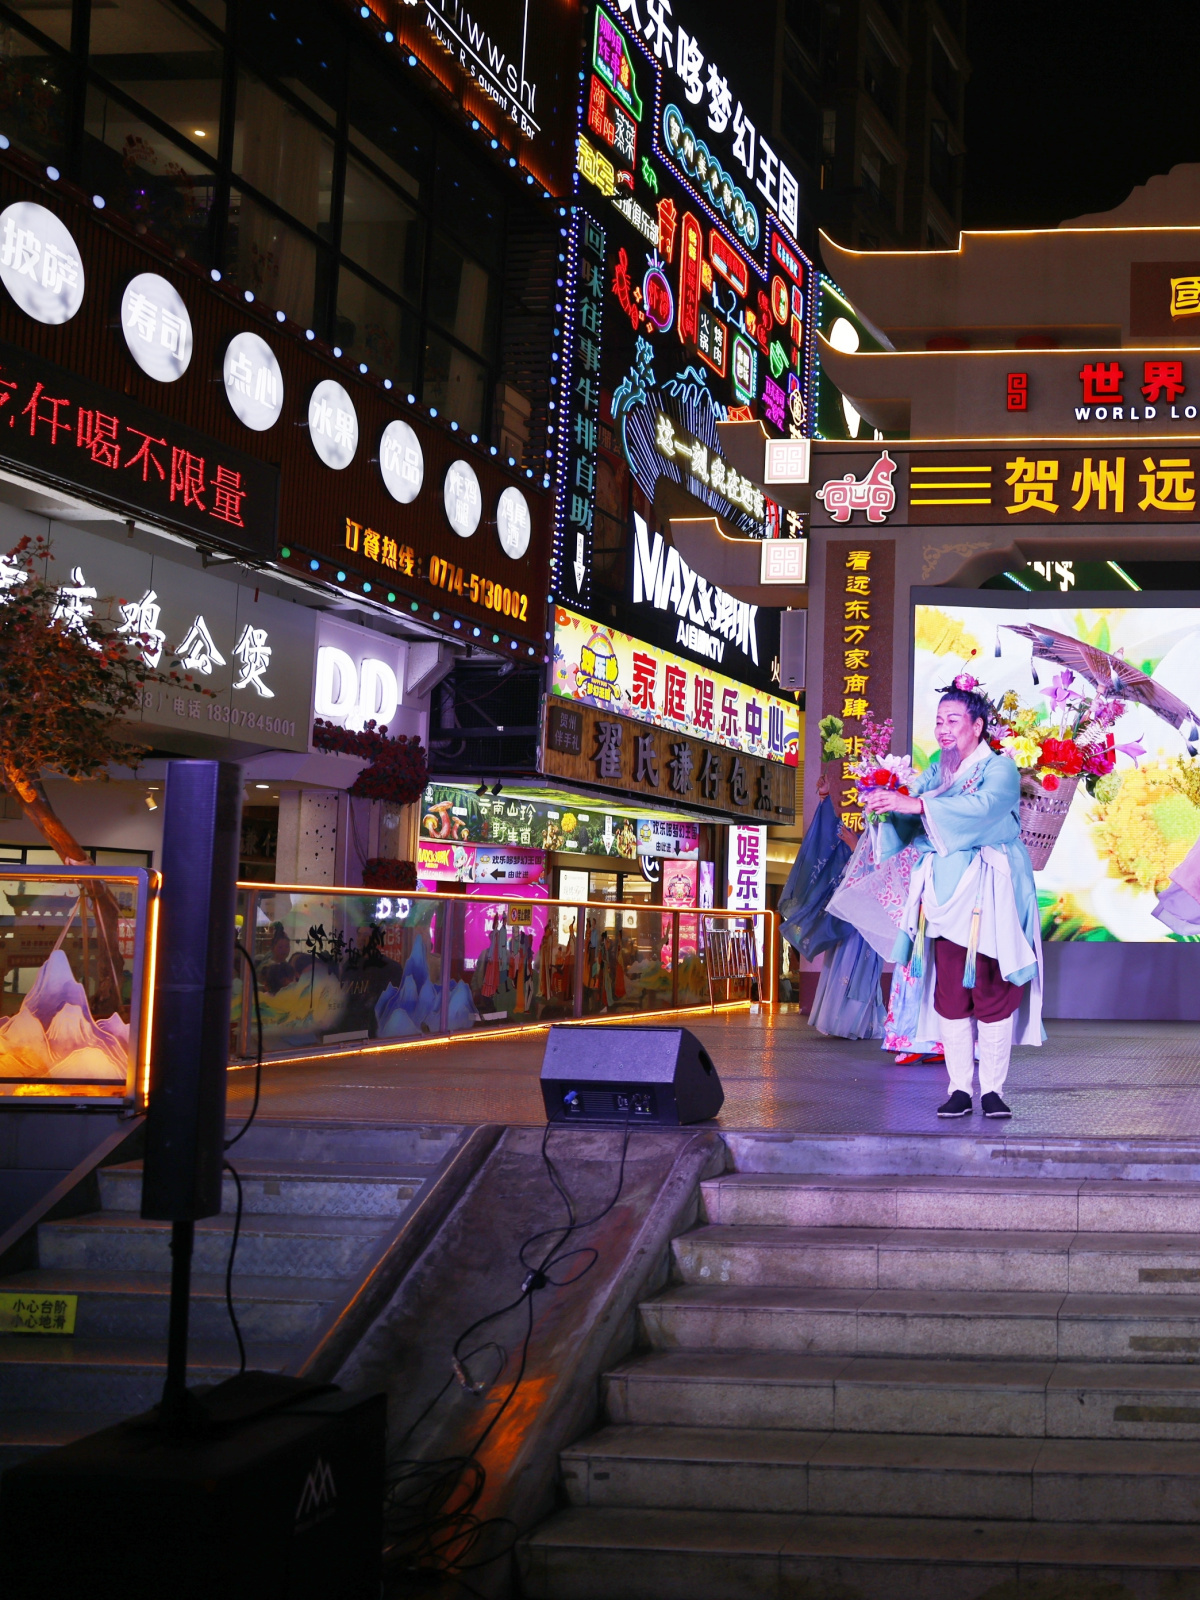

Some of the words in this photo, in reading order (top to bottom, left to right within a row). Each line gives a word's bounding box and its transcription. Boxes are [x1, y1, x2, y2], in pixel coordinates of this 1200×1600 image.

[520, 115, 535, 140] Bar
[1, 216, 79, 294] 披萨
[127, 289, 188, 362] 寿司
[227, 351, 278, 411] 点心
[569, 216, 604, 532] 回味往事牛排自助
[311, 397, 355, 453] 水果
[1075, 405, 1157, 421] WORLD
[383, 434, 421, 486] 饮品
[429, 555, 528, 623] 0774-5130002
[172, 696, 202, 721] 电话
[206, 703, 297, 737] 18307845001
[560, 711, 577, 730] 贺州
[632, 651, 785, 753] 家庭娱乐中心
[595, 720, 773, 812] 翟氏谦仔包点
[478, 798, 536, 826] 云南山珍
[492, 822, 532, 845] 野生菌
[507, 870, 529, 879] 由此进
[736, 825, 760, 929] 娱乐中
[11, 1314, 67, 1330] 小心地滑
[13, 1299, 68, 1314] 小心台阶
